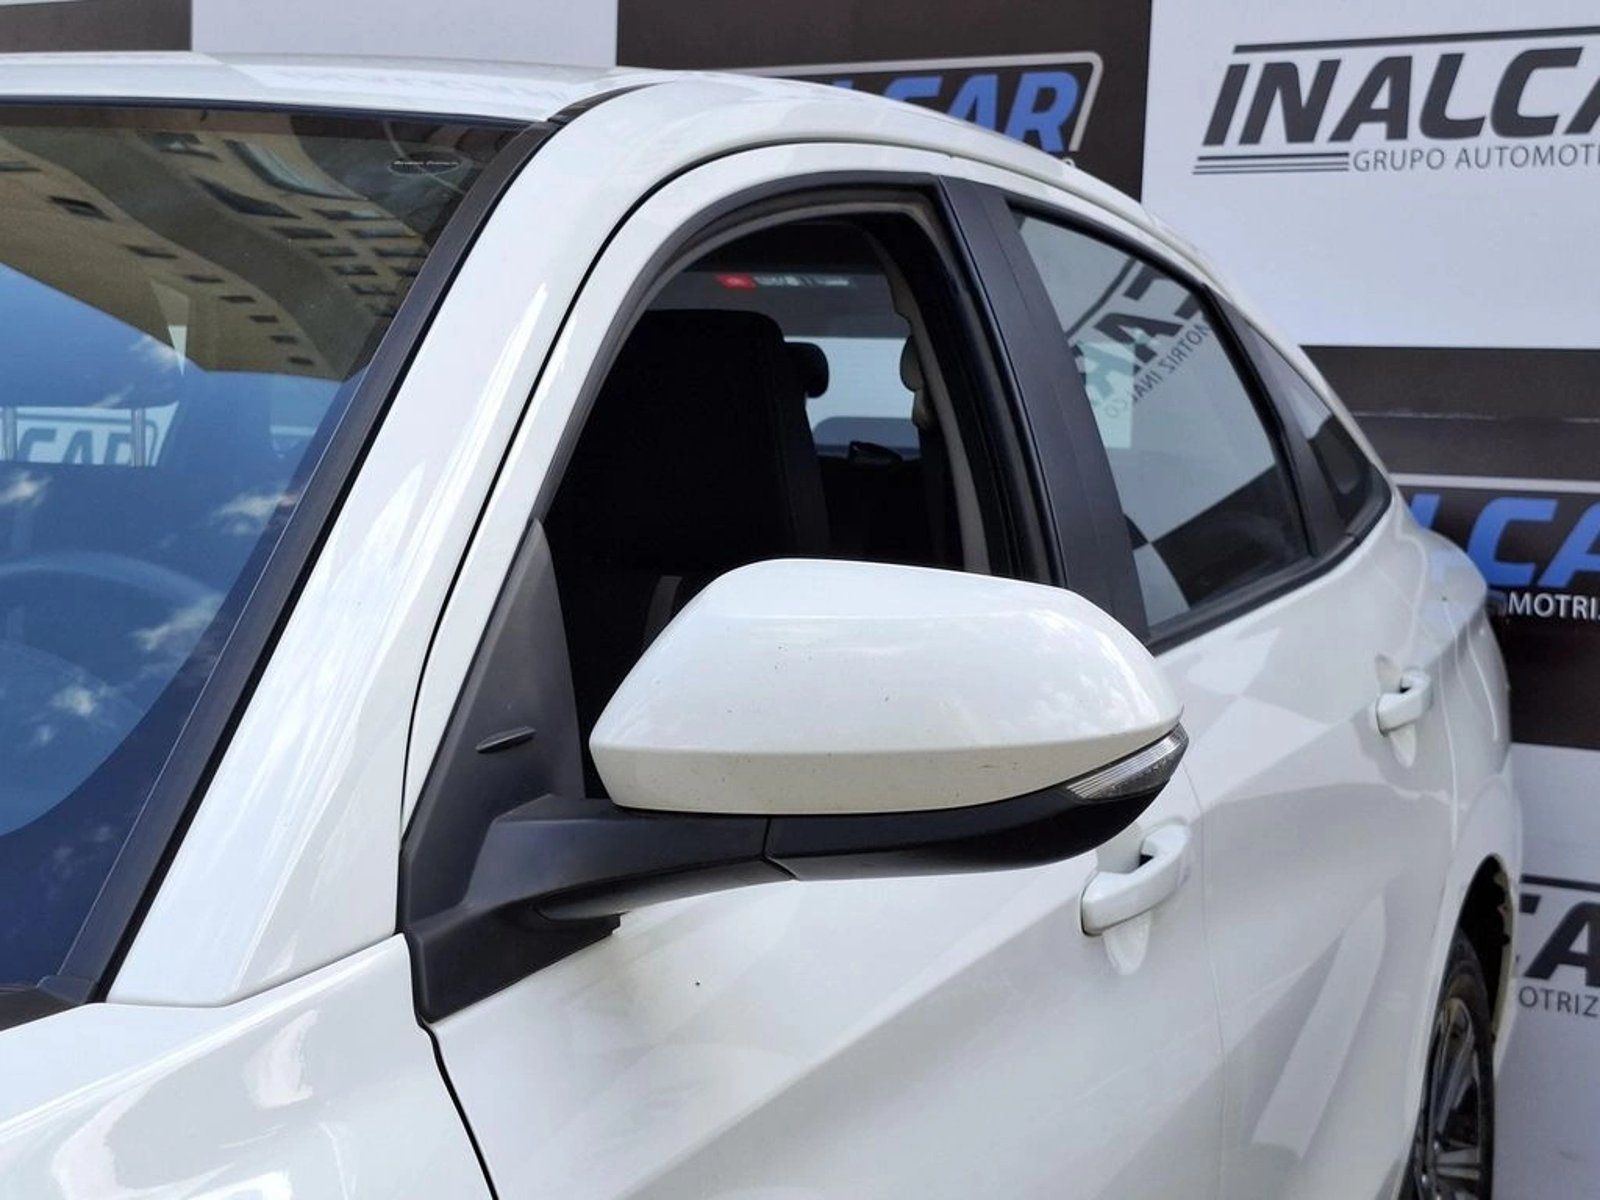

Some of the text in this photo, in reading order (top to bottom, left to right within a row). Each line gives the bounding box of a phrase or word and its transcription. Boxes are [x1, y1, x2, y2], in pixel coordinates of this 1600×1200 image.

[831, 70, 1080, 154] AR
[1352, 143, 1600, 172] GRUPO AUTOMOT
[1508, 591, 1600, 619] MOTRI
[1520, 893, 1600, 989] A
